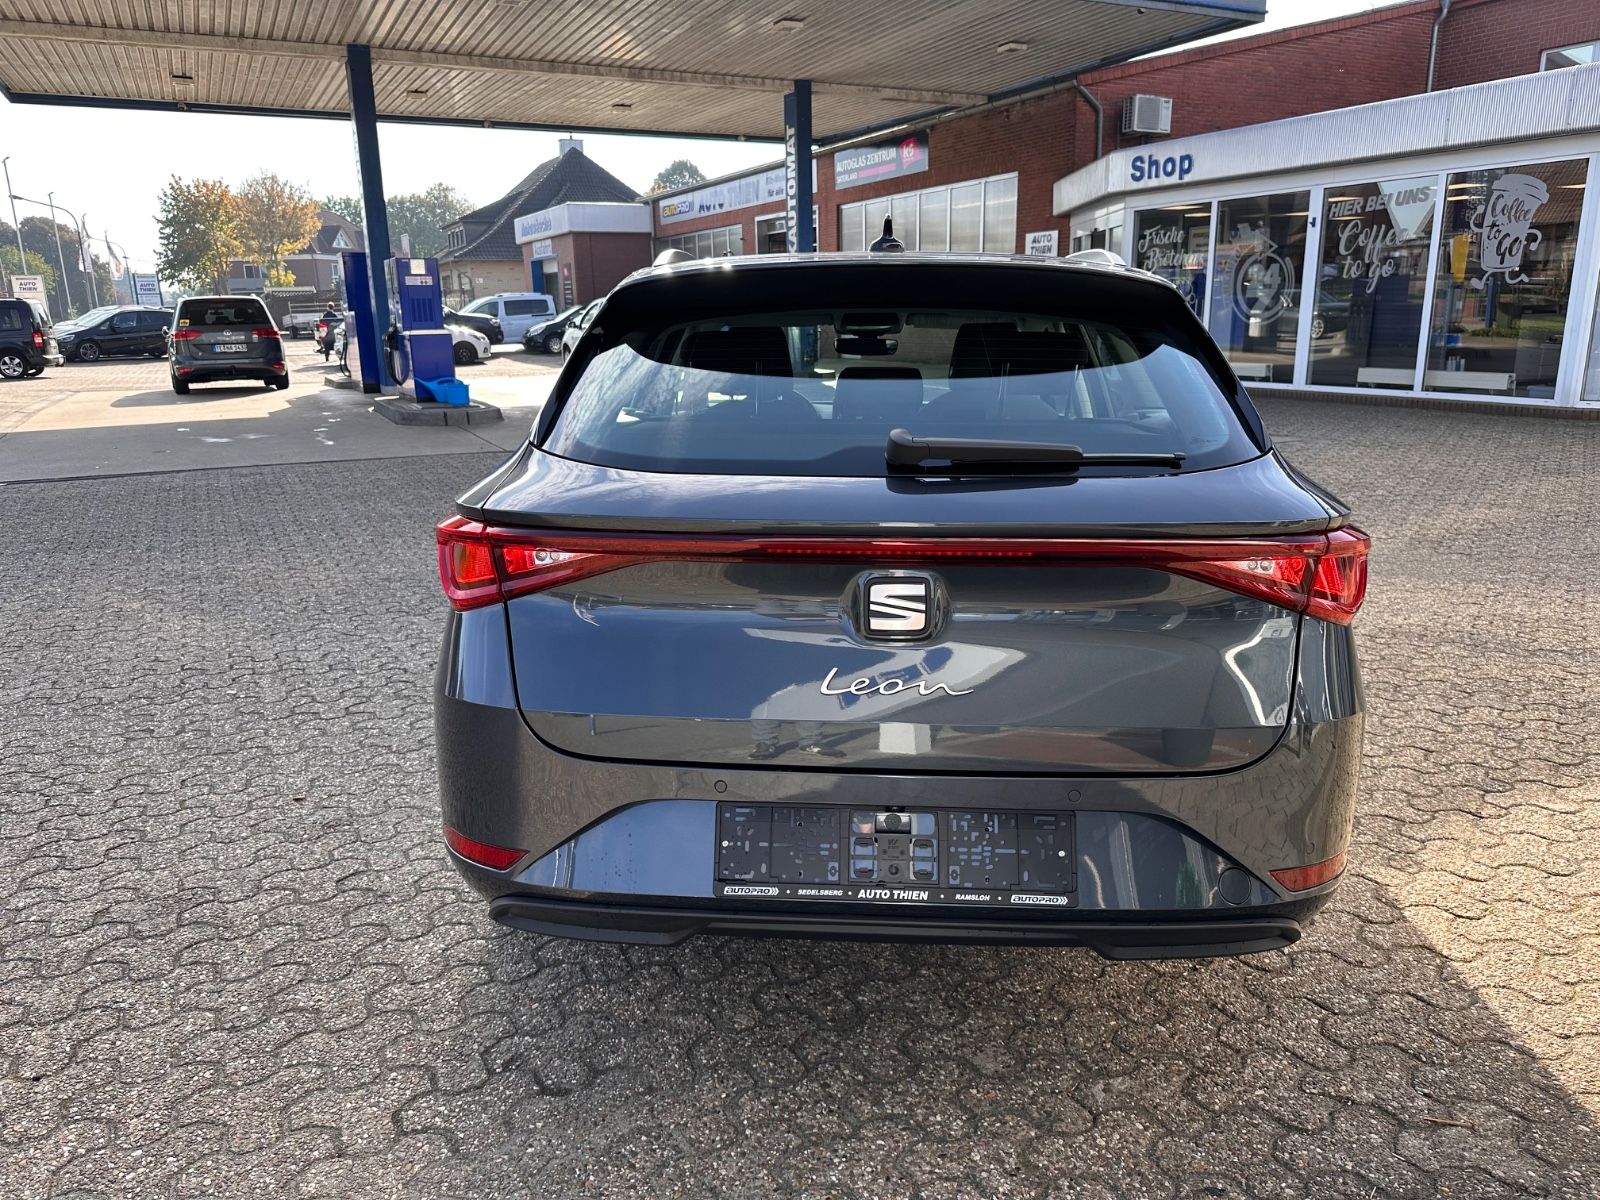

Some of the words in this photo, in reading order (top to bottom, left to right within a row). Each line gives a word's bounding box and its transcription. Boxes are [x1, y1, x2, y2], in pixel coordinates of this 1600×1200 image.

[836, 155, 867, 172] AUTOGLAS
[867, 147, 897, 164] ZENTRUM
[1131, 153, 1193, 182] Shop
[698, 189, 725, 214] AUTO
[727, 179, 760, 209] THIEN
[1329, 199, 1364, 218] HIER
[1365, 192, 1393, 213] BEI
[1395, 186, 1431, 206] UNS
[1491, 193, 1531, 224] Coffee
[1031, 233, 1052, 245] AUTO
[1138, 225, 1184, 253] Frische
[1338, 219, 1410, 264] Coffee
[1485, 220, 1502, 240] to
[1030, 245, 1053, 254] THIEN
[1341, 255, 1364, 279] to
[1365, 258, 1396, 294] go
[820, 667, 974, 695] Leon
[797, 888, 843, 896] SEDELSBERG
[857, 889, 890, 899] AUTO
[892, 890, 929, 900] THIEN
[955, 893, 990, 901] RAMSLOH
